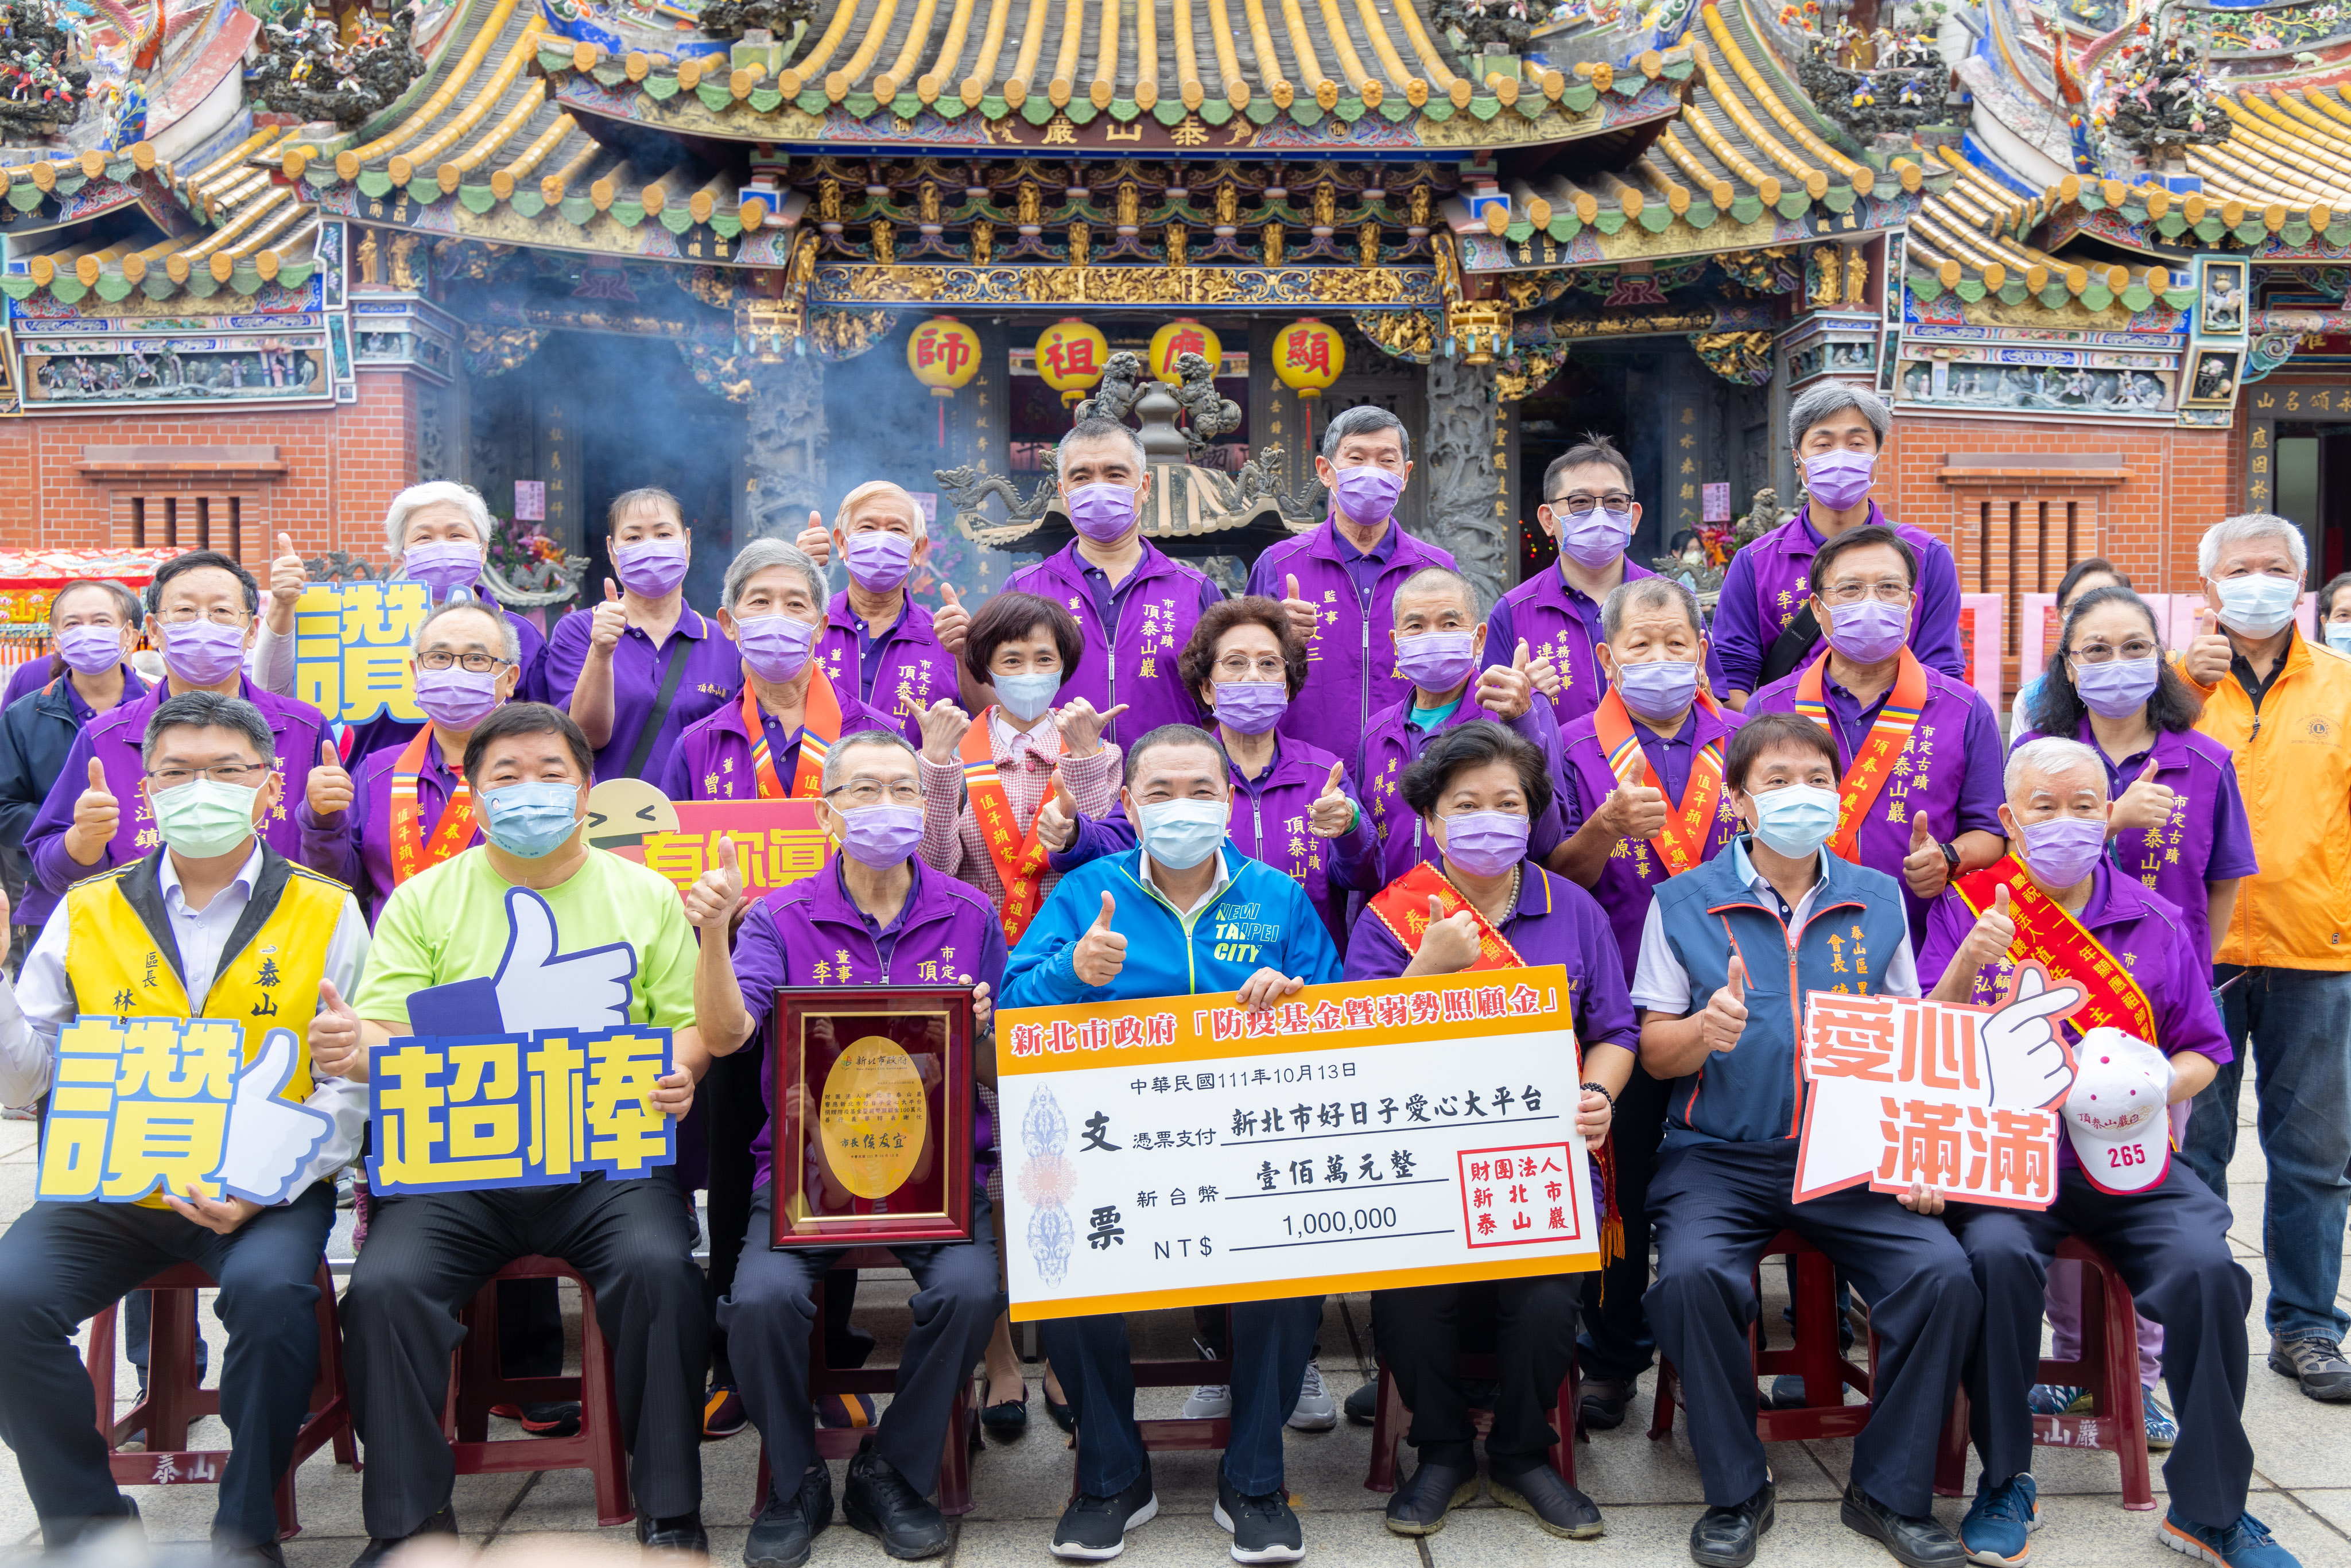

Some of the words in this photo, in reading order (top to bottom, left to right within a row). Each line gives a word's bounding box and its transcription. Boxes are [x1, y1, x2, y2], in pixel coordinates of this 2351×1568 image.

[917, 328, 971, 375] 師
[1044, 333, 1099, 379] 祖
[1286, 329, 1330, 378] 顯
[1160, 599, 1175, 649] 市定古蹟
[1324, 590, 1338, 625] 監事
[296, 583, 432, 721] 讚
[1138, 604, 1159, 678] 頂泰山巖
[1556, 629, 1573, 690] 常務董事
[828, 649, 841, 680] 董事
[914, 659, 933, 711] 市定古蹟
[723, 756, 734, 798] 董事
[1385, 758, 1396, 797] 董事
[1912, 725, 1935, 791] 市定古蹟
[1887, 735, 1914, 824] 頂泰山巖
[397, 808, 415, 879] 值年頭家
[430, 804, 473, 868] 頂泰山
[980, 794, 1018, 863] 值年頭家
[2164, 795, 2189, 864] 市定古蹟
[1283, 816, 1308, 888] 頂泰山
[1215, 902, 1260, 921] NEW
[1215, 922, 1279, 942] TAIPEI
[2007, 895, 2044, 944] 團法人
[142, 951, 158, 988] 區長
[813, 960, 832, 984] 李
[836, 949, 853, 984] 董事
[1214, 942, 1263, 962] CITY
[1826, 934, 1849, 974] 會長
[252, 957, 281, 1018] 泰山
[2030, 946, 2113, 1028] 值年主
[1011, 983, 1558, 1057] 新北市政府「防疫基金暨弱勢照顧金」
[855, 1054, 907, 1066] 新北市政府
[1811, 999, 1980, 1090] 愛心
[1130, 1062, 1356, 1096] 中華民國111年10月13日
[39, 1019, 239, 1197] 讚
[378, 1035, 666, 1186] 超棒
[1231, 1085, 1543, 1138] 新北市好日子愛心大平台
[2077, 1113, 2131, 1130] 頂泰山巖
[840, 1138, 859, 1148] 市長
[863, 1132, 907, 1150] 侯友宜
[1132, 1127, 1217, 1151] 憑票支付
[1877, 1097, 2057, 1198] 滿滿
[2107, 1143, 2146, 1168] 265
[1256, 1150, 1417, 1191] 壹佰萬元整
[1471, 1156, 1563, 1183] 財團法人
[1136, 1184, 1219, 1209] 新台幣
[1473, 1181, 1563, 1209] 新北市
[1283, 1206, 1397, 1240] 1,000,000
[1477, 1206, 1570, 1236] 泰山巖
[2034, 1416, 2101, 1450] 山巖
[152, 1454, 216, 1485] 泰山
